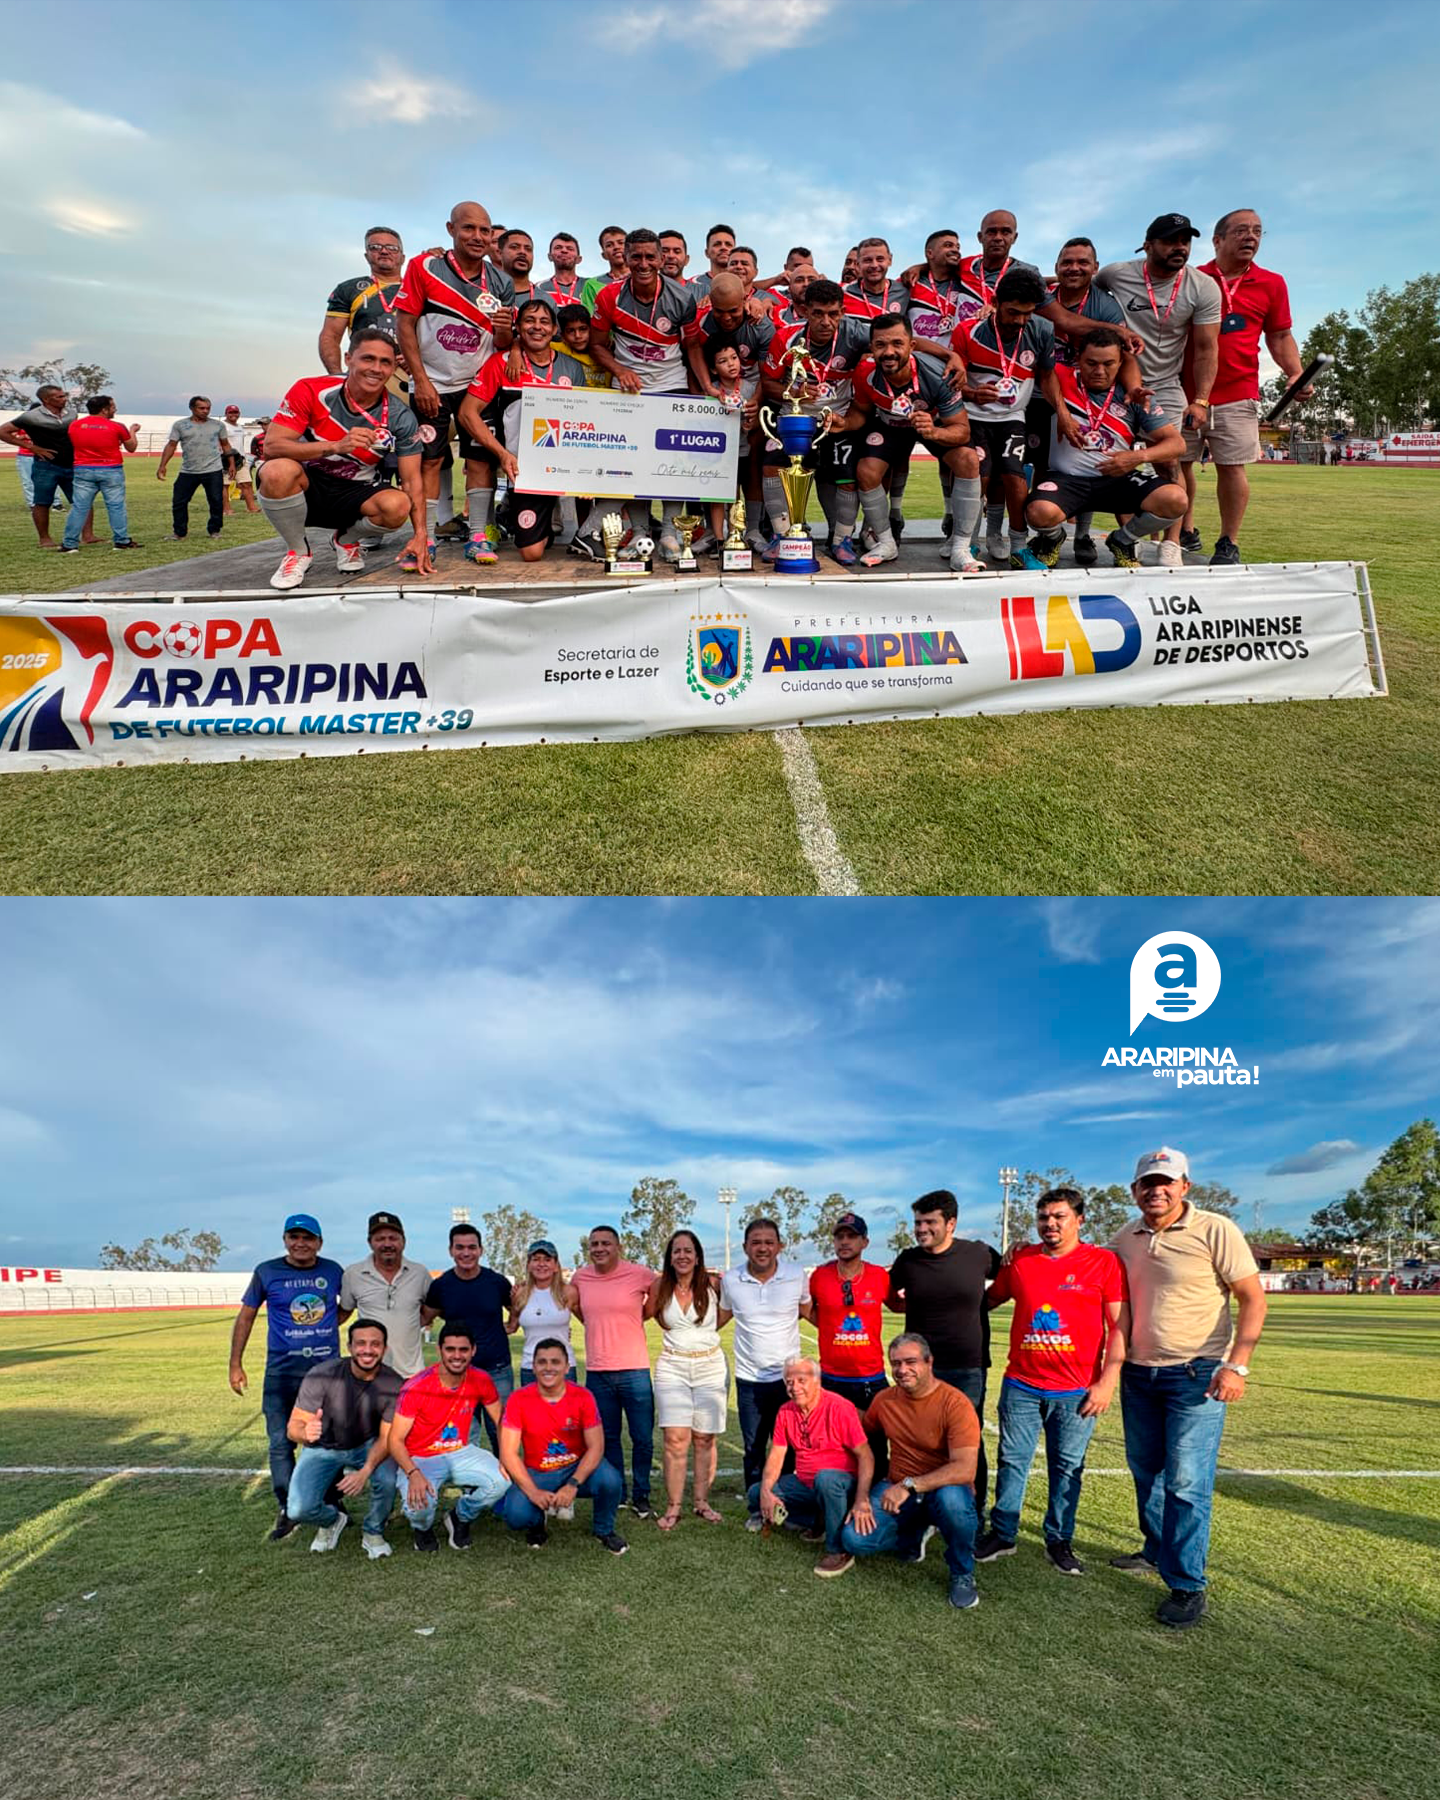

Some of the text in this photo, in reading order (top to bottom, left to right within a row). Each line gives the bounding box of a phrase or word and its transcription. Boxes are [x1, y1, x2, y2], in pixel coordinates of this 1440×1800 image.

[672, 403, 685, 413] R$
[562, 421, 595, 431] COPA
[562, 431, 627, 443] ARARIPINA
[681, 435, 720, 447] LUGAR
[1001, 438, 1026, 462] 14
[833, 445, 853, 465] 17
[1148, 595, 1203, 617] LIGA
[123, 618, 283, 660] COPA
[1156, 615, 1303, 642] ARARIPINENSE
[2, 652, 50, 670] 2025
[557, 645, 660, 664] Secretaria de
[762, 630, 969, 674] ARARIPINA
[1153, 640, 1310, 666] DE DESPORTOS
[112, 661, 428, 709] ARARIPINA
[544, 664, 660, 686] Esporte e Lazer
[781, 673, 953, 695] Cuidando que se transforma
[112, 709, 474, 741] DE FUTEBOL MASTER +39
[0, 1268, 63, 1283] IPE
